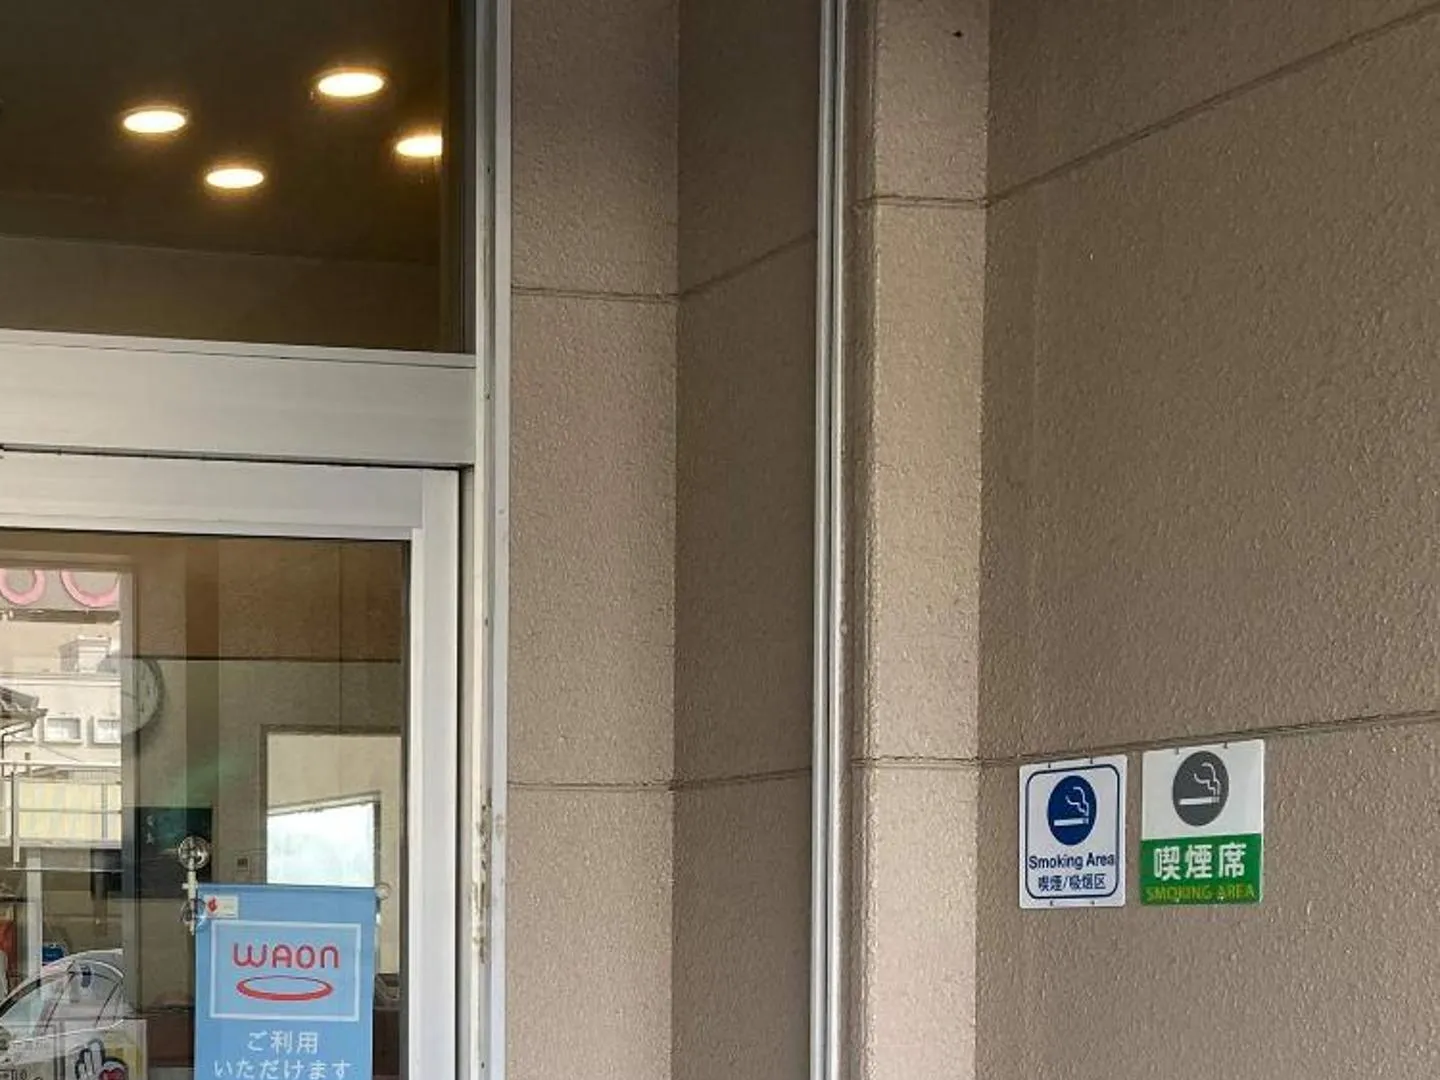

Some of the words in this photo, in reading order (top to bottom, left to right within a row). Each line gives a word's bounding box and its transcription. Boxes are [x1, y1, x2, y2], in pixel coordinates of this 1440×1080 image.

[1028, 854, 1083, 871] Smoking
[1086, 852, 1116, 867] Area
[1152, 842, 1247, 881] 喫煙席
[1145, 883, 1213, 902] SMOKING
[1216, 881, 1257, 900] AREA
[231, 943, 341, 969] WAON
[246, 1030, 319, 1054] ご利用
